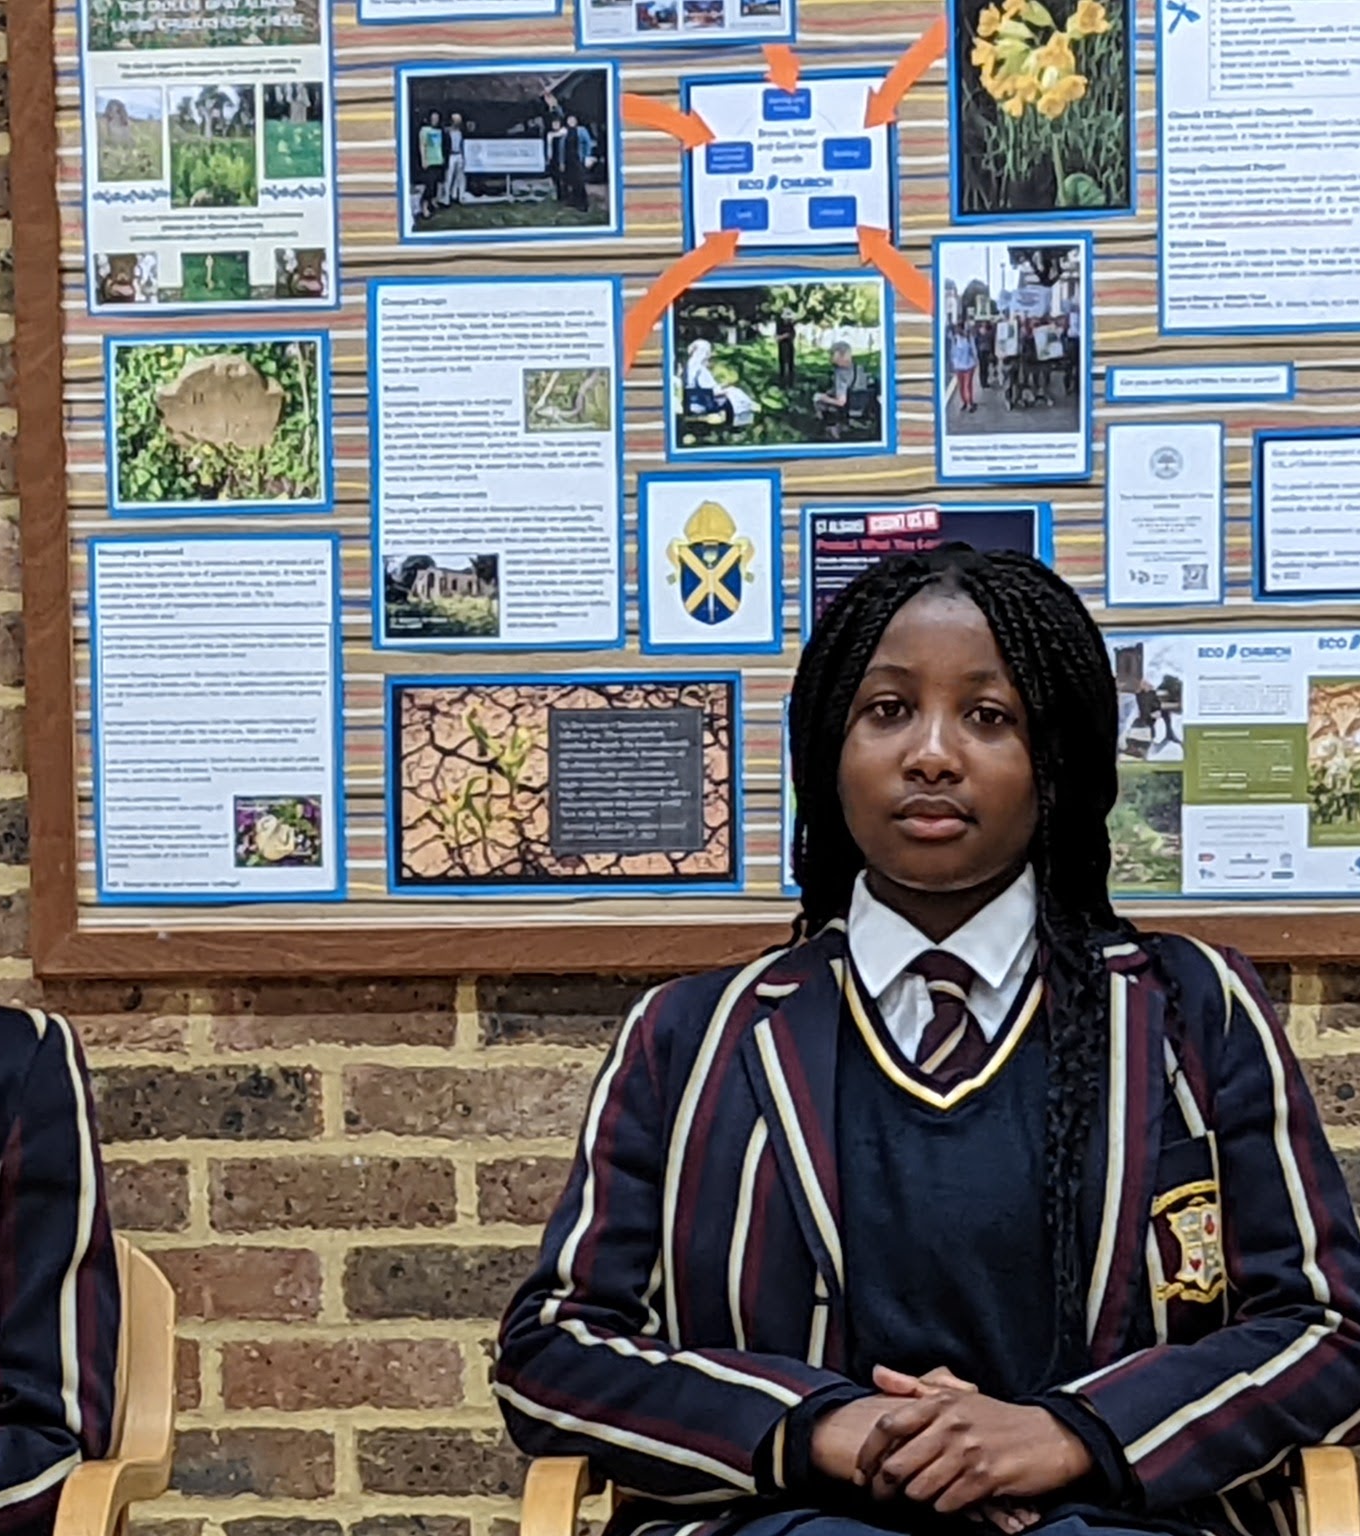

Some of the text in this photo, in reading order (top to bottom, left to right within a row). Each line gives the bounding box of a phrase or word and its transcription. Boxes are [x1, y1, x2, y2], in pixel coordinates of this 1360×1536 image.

[738, 176, 834, 191] ECO CHURCH
[1318, 637, 1348, 650] ECO
[1197, 645, 1292, 659] ECO CHURCH
